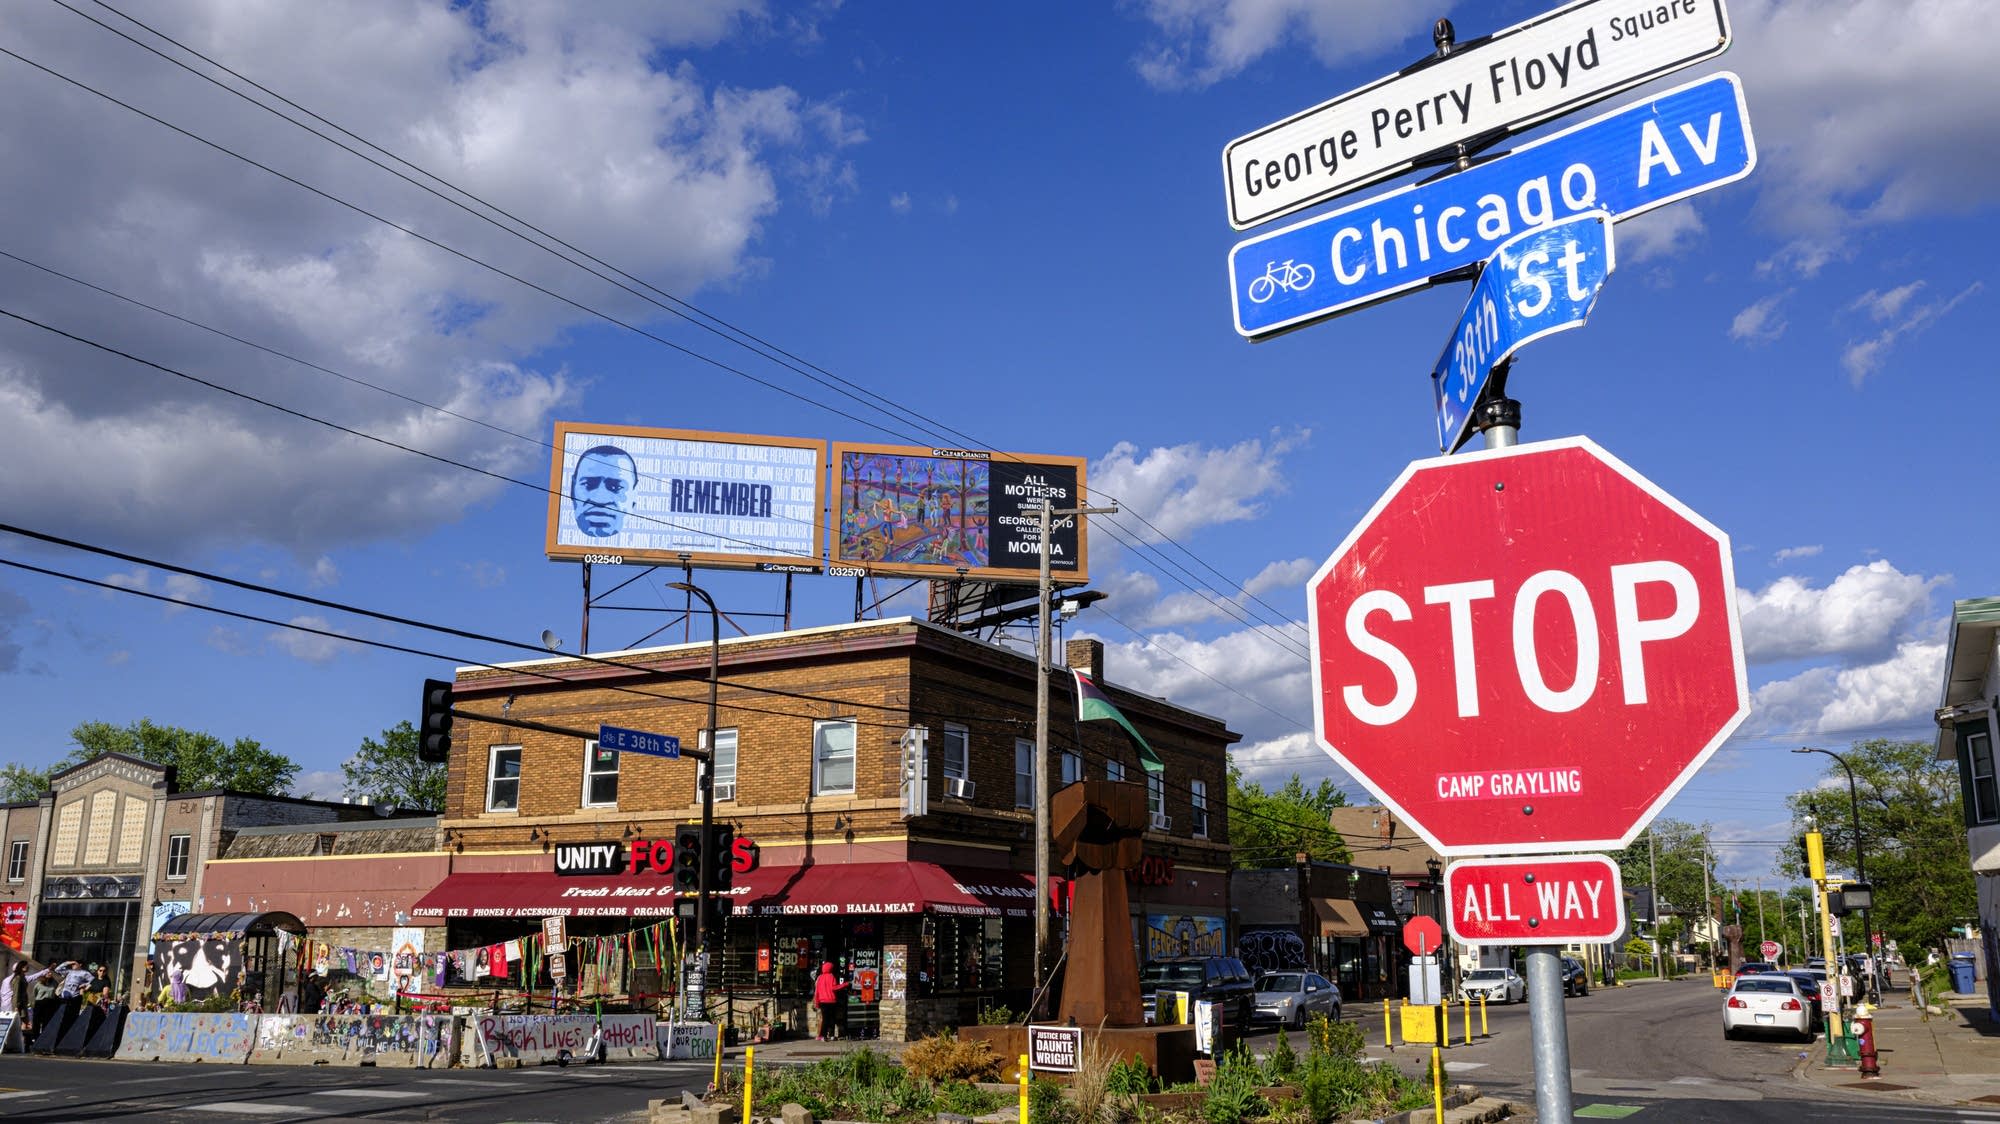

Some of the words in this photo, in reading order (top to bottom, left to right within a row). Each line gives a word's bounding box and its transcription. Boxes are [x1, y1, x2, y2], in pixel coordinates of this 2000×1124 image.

[1244, 130, 1358, 197] George
[1371, 83, 1473, 148] Perry
[1489, 29, 1600, 104] Floyd
[1610, 0, 1697, 42] Square
[1331, 162, 1597, 286] Chicago
[1637, 112, 1722, 188] Av
[1439, 369, 1455, 437] E
[1455, 298, 1499, 404] 38th
[1517, 237, 1588, 317] St
[1024, 475, 1048, 486] ALL
[670, 478, 772, 518] REMEMBER
[1005, 485, 1066, 498] MOTHERS
[584, 554, 622, 565] 032540
[829, 567, 865, 577] 032570
[1342, 560, 1700, 726] STOP
[618, 733, 626, 746] E
[631, 735, 659, 752] 38th
[664, 740, 677, 754] St
[1437, 775, 1485, 799] CAMP
[1490, 770, 1581, 796] GRAYLING
[556, 845, 616, 870] UNITY
[630, 837, 753, 874] FOS
[561, 887, 608, 897] Fresh
[610, 886, 655, 896] Meat
[656, 885, 674, 896] &
[1462, 884, 1521, 923] ALL
[1536, 879, 1603, 919] WAY
[413, 908, 443, 916] STAMPS
[448, 908, 468, 916] KEYS
[473, 908, 505, 916] PHONES
[506, 907, 513, 916] &
[515, 907, 571, 916] ACCESSORIES
[577, 907, 595, 916] BUS
[597, 907, 627, 916] CARDS
[761, 904, 808, 914] MEXICAN
[810, 904, 838, 913] FOOD
[846, 904, 883, 913] HALAL
[884, 903, 915, 912] MEAT
[958, 905, 985, 915] EASTERN
[778, 952, 799, 966] CBD
[856, 950, 875, 958] NOW
[672, 1026, 704, 1036] PROTECT
[1037, 1031, 1058, 1039] JUSTICE
[1059, 1032, 1072, 1040] FOR
[675, 1036, 690, 1046] OUR
[691, 1037, 717, 1057] PEOPL
[1036, 1040, 1074, 1053] DAUNTE
[1036, 1052, 1074, 1065] WRIGHT
